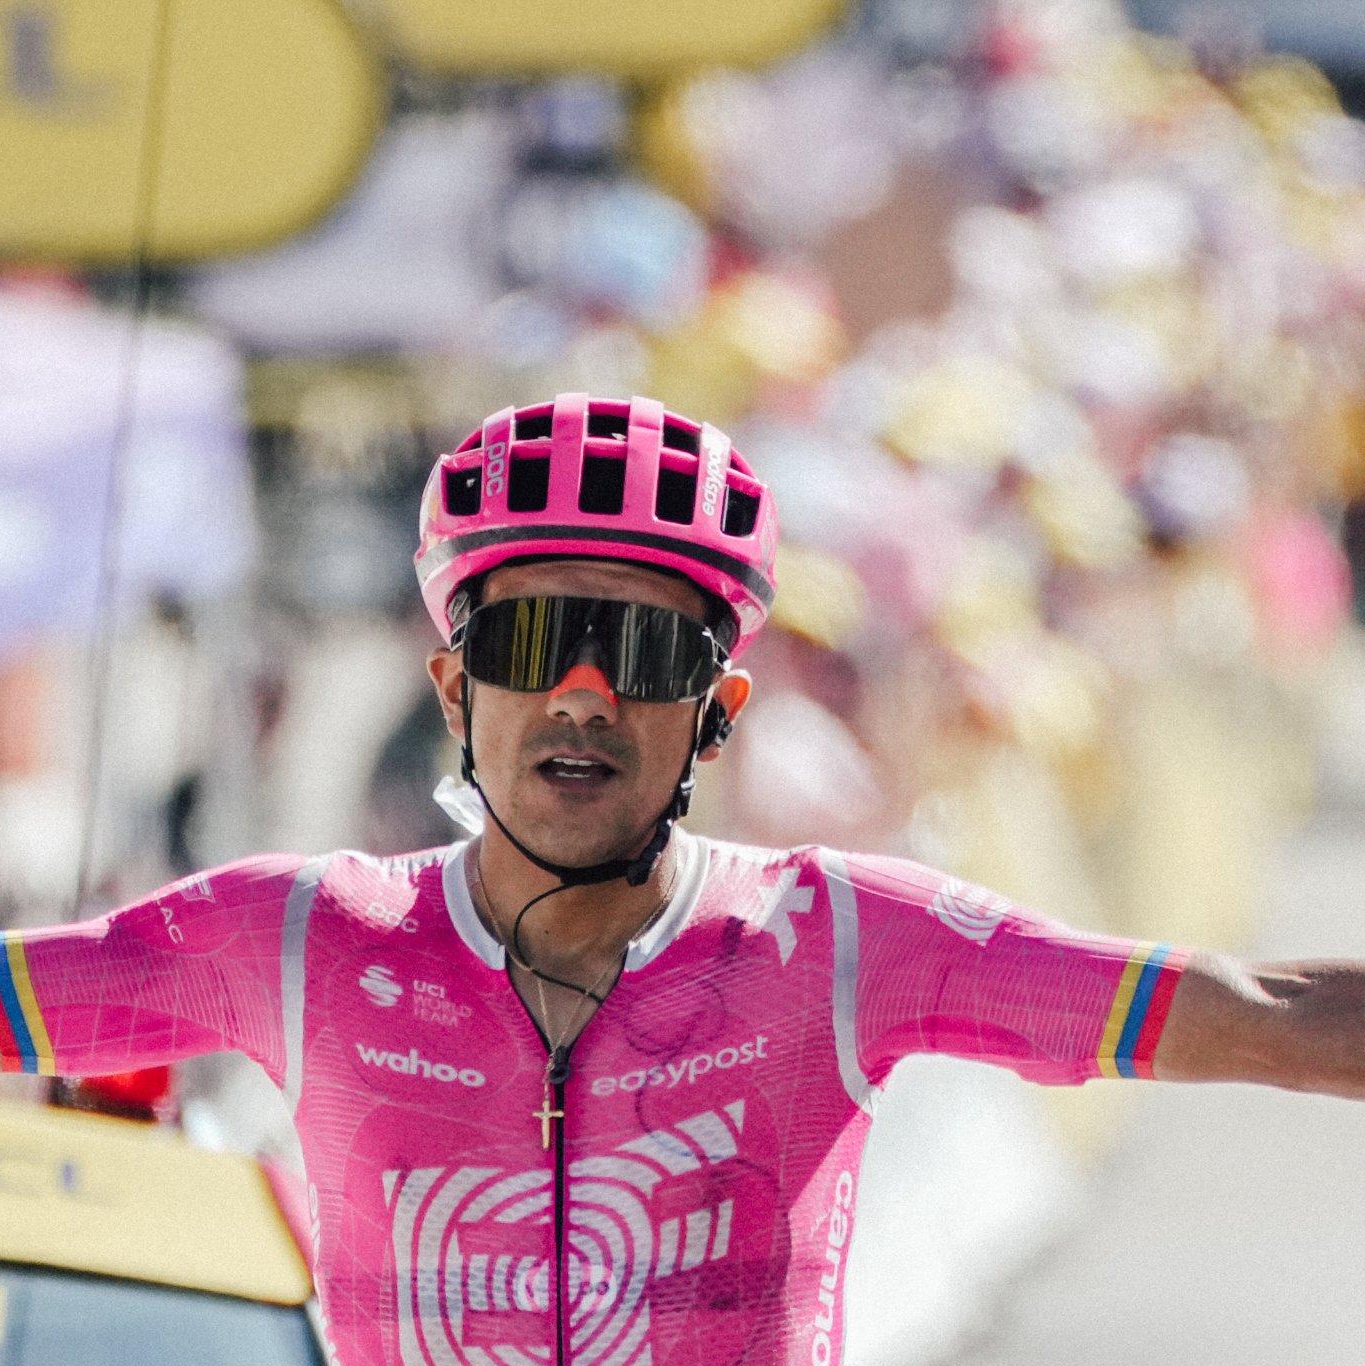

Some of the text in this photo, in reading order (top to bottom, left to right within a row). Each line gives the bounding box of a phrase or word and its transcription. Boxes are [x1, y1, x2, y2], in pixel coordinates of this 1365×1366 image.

[413, 979, 445, 999] UCI
[355, 1042, 486, 1088] wahoo
[590, 1035, 769, 1098] easypost
